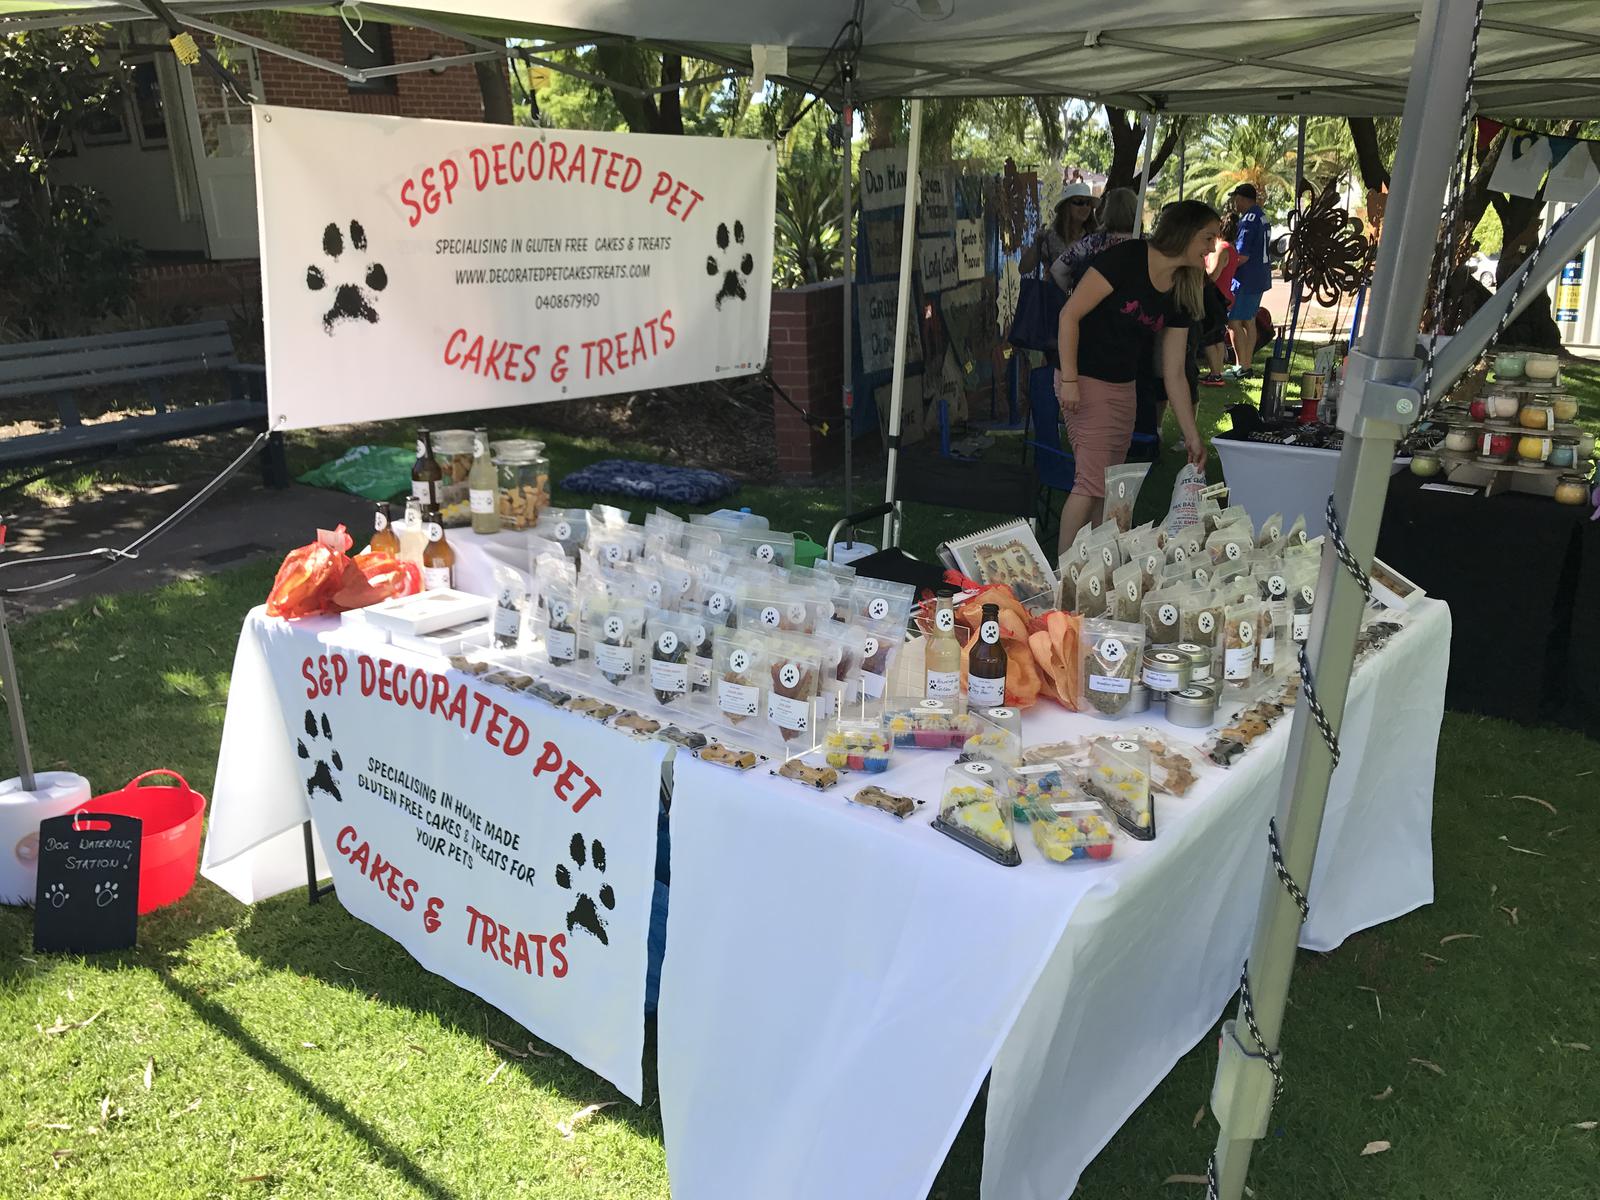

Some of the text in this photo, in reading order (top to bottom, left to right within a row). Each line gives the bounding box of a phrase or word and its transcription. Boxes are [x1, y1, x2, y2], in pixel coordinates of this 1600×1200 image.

[401, 140, 704, 228] S&P DECORATED PET
[436, 236, 671, 254] SPECIALISING IN GLUTEN FREE CAKES & TREATS
[455, 264, 651, 285] WWW.DECORATEDPETCAKESTREATS.COM
[535, 293, 600, 310] 0408679190
[444, 310, 676, 383] CAKES & TREATS
[302, 654, 602, 813] S&P DECORATED PET
[358, 774, 536, 887] GLUTEN FREE CAKES & TREATS FOR
[368, 757, 520, 851] SPECIALISING IN HOME MADE
[44, 837, 133, 851] DOG WATERING
[416, 827, 474, 870] YOUR PETS
[336, 825, 569, 978] CAKES & TREATS
